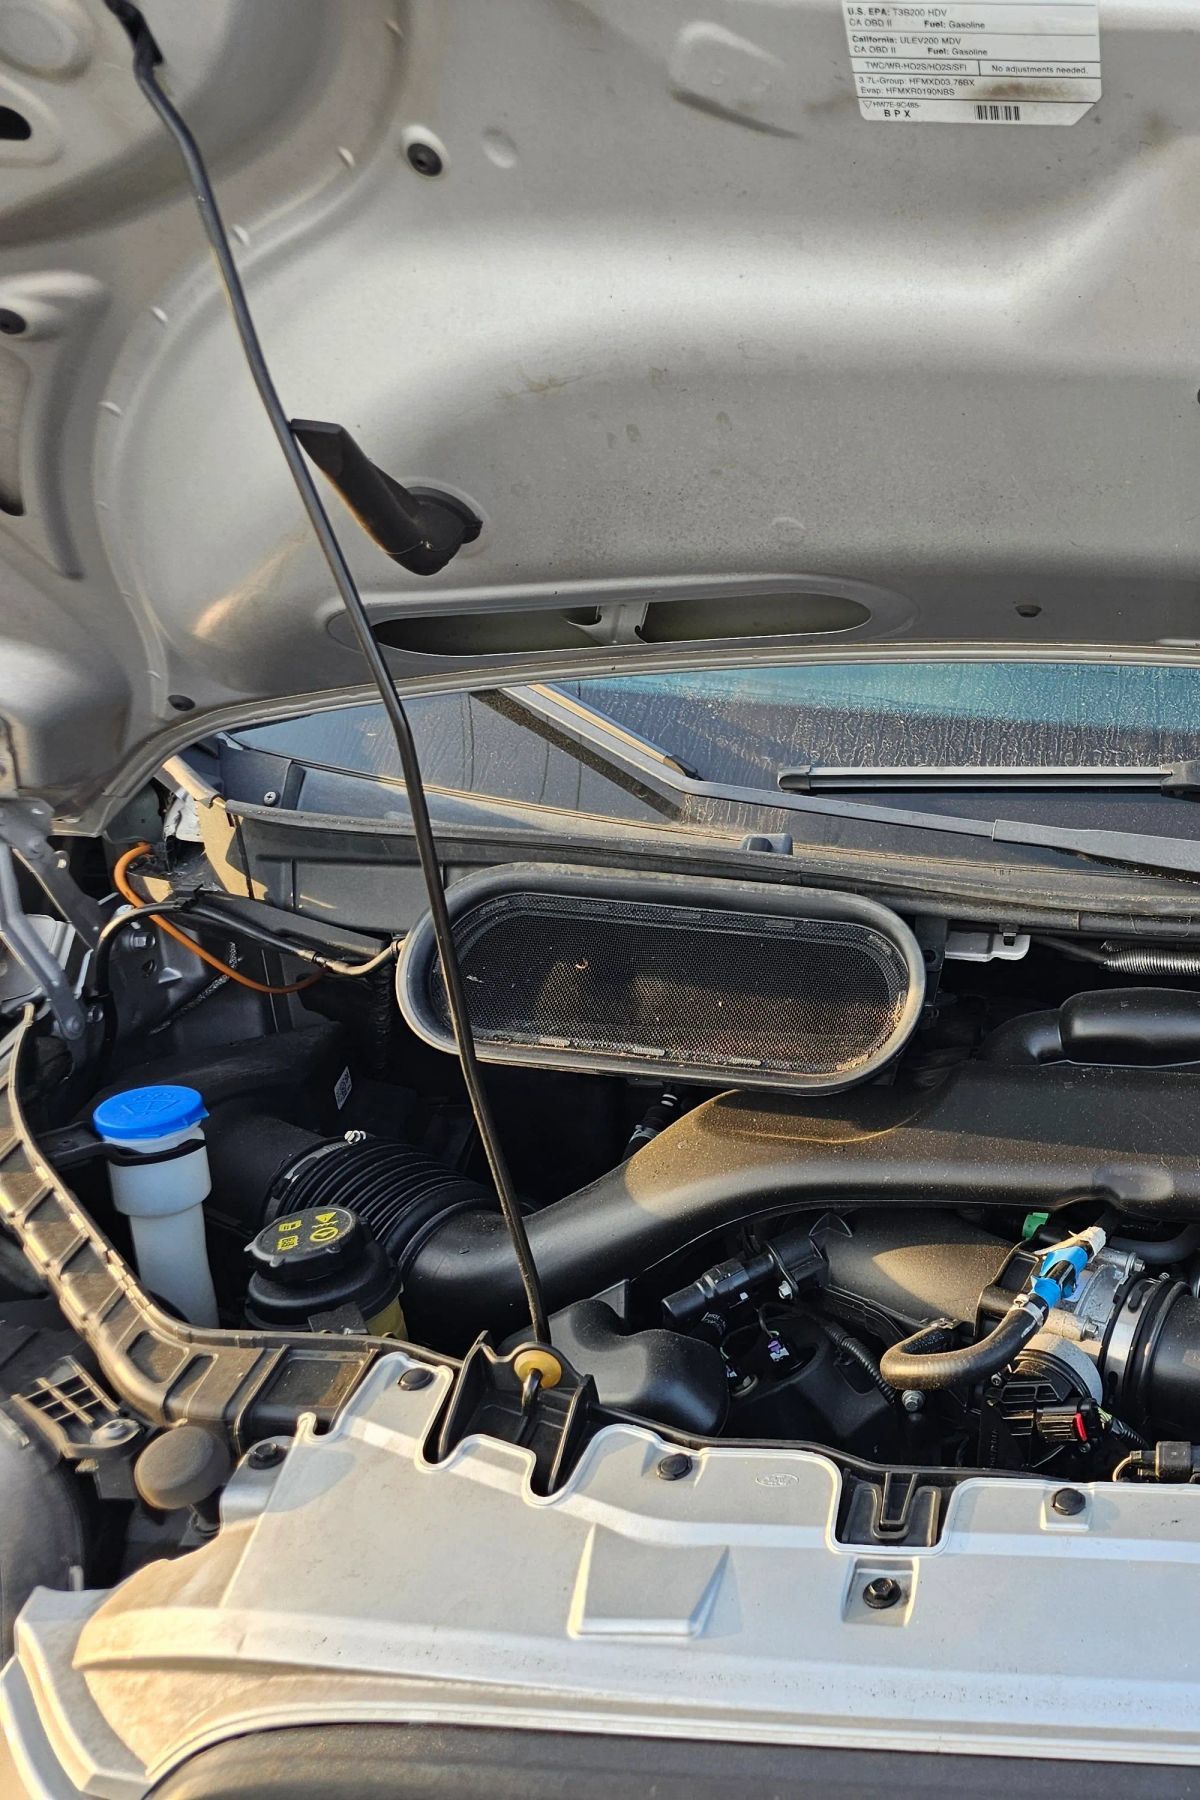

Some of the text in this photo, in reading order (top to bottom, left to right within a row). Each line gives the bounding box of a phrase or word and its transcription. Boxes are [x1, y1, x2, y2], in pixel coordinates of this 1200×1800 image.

[847, 8, 866, 17] U.S.
[868, 8, 891, 17] EPA:
[928, 9, 948, 17] HDV
[849, 18, 863, 27] CA
[864, 18, 885, 27] OBD
[924, 20, 986, 30] Fuel: Gasoline
[852, 35, 961, 46] California: ULEV200 MDV
[854, 45, 868, 54] CA
[869, 46, 889, 54] OBD
[927, 47, 988, 57] Fuel: Gasoline
[992, 64, 1089, 75] No adjustments needed.
